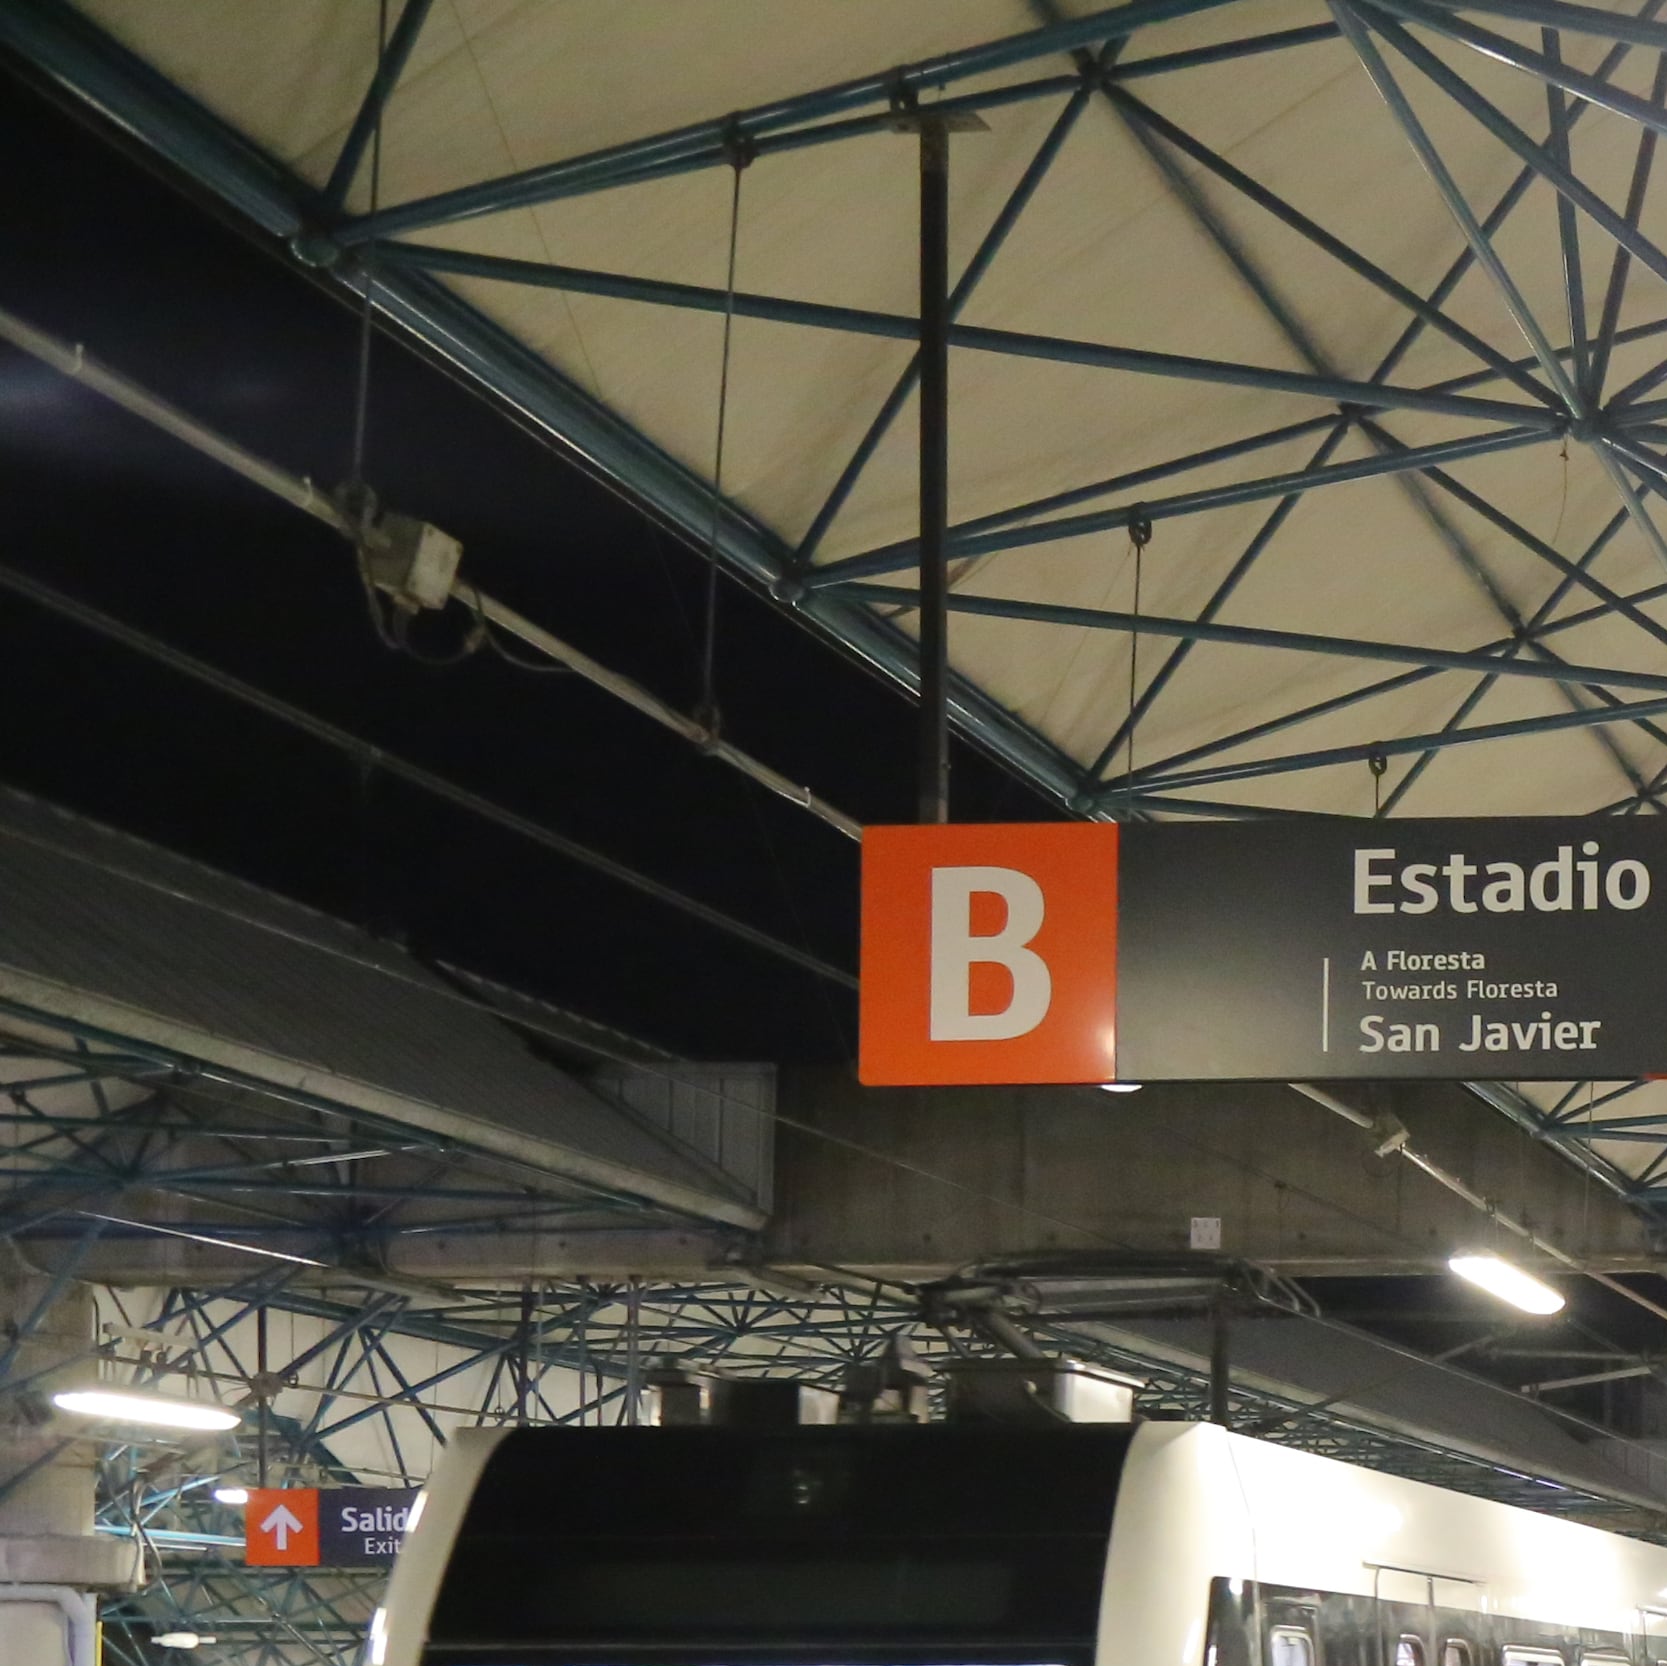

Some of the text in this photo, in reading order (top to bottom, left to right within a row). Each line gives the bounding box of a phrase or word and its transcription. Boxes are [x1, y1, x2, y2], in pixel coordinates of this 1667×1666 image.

[1353, 841, 1651, 914] Estadio
[930, 865, 1053, 1041] B
[1360, 950, 1486, 971] A Floresta
[1362, 979, 1558, 1000] Towards Floresta
[1359, 1011, 1602, 1053] San Javier
[341, 1506, 409, 1532] Salid
[364, 1536, 401, 1555] Exit
